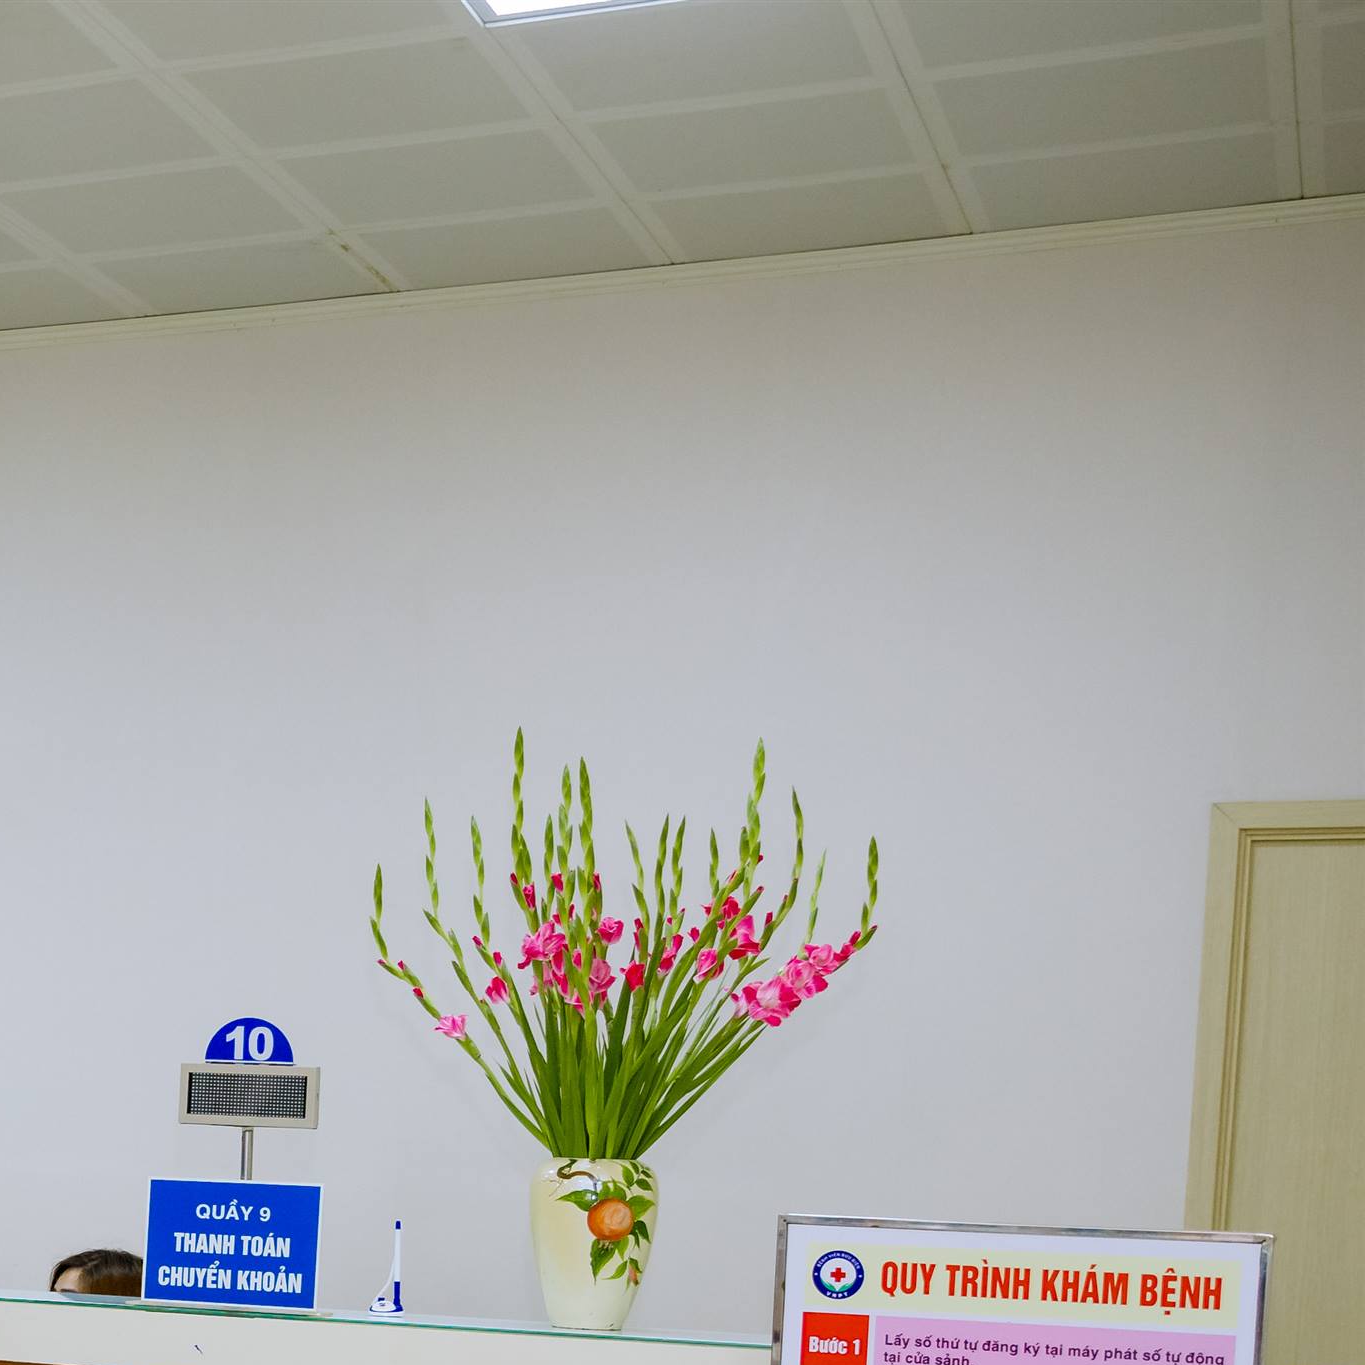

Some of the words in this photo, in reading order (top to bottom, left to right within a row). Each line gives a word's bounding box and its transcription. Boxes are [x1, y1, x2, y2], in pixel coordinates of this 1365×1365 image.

[226, 1025, 274, 1061] 10
[195, 1198, 254, 1221] QUẦY
[259, 1207, 271, 1222] 9
[174, 1232, 235, 1255] THANH
[241, 1232, 291, 1258] TOÁN
[158, 1260, 231, 1289] CHUYỂN
[237, 1265, 302, 1293] KHOẢN
[881, 1261, 936, 1298] QUY
[945, 1258, 1031, 1300] TRÌNH
[1040, 1264, 1129, 1305] KHÁM
[1139, 1267, 1222, 1315] BỆNH
[808, 1335, 848, 1354] Bước
[853, 1339, 860, 1355] 1
[883, 1351, 901, 1365] tại
[904, 1351, 931, 1365] cửa
[884, 1332, 911, 1350] Lấy
[914, 1334, 934, 1348] số
[935, 1337, 961, 1350] thứ
[963, 1338, 980, 1353] tự
[981, 1339, 1019, 1357] đăng
[1023, 1341, 1041, 1358] ký
[1044, 1343, 1064, 1359] tại
[1067, 1345, 1100, 1361] máy
[1103, 1347, 1138, 1362] phát
[1141, 1347, 1163, 1362] số
[1165, 1350, 1183, 1365] tự
